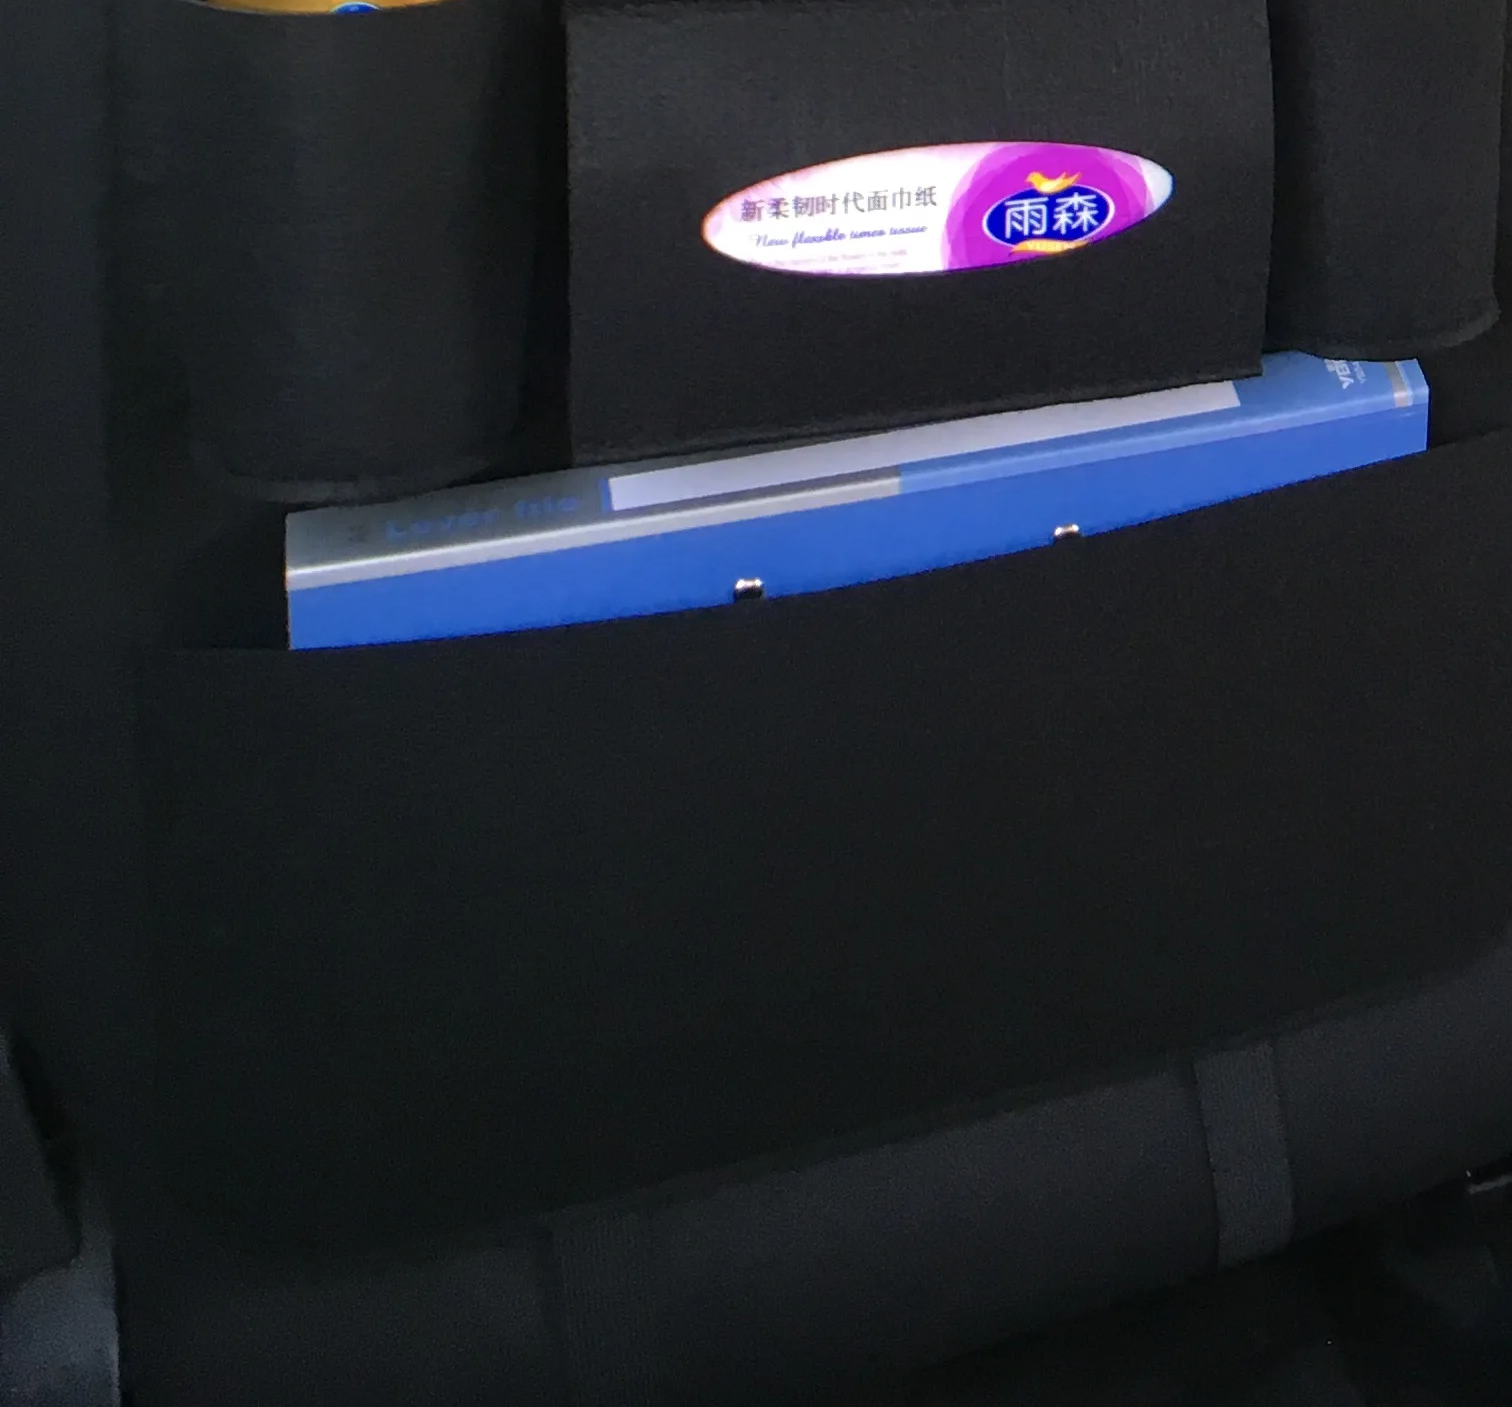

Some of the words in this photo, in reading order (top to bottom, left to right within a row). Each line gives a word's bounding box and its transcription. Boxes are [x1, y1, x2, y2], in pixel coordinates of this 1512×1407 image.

[739, 186, 938, 222] 新柔韧时代面巾纸
[1003, 191, 1099, 239] 雨森
